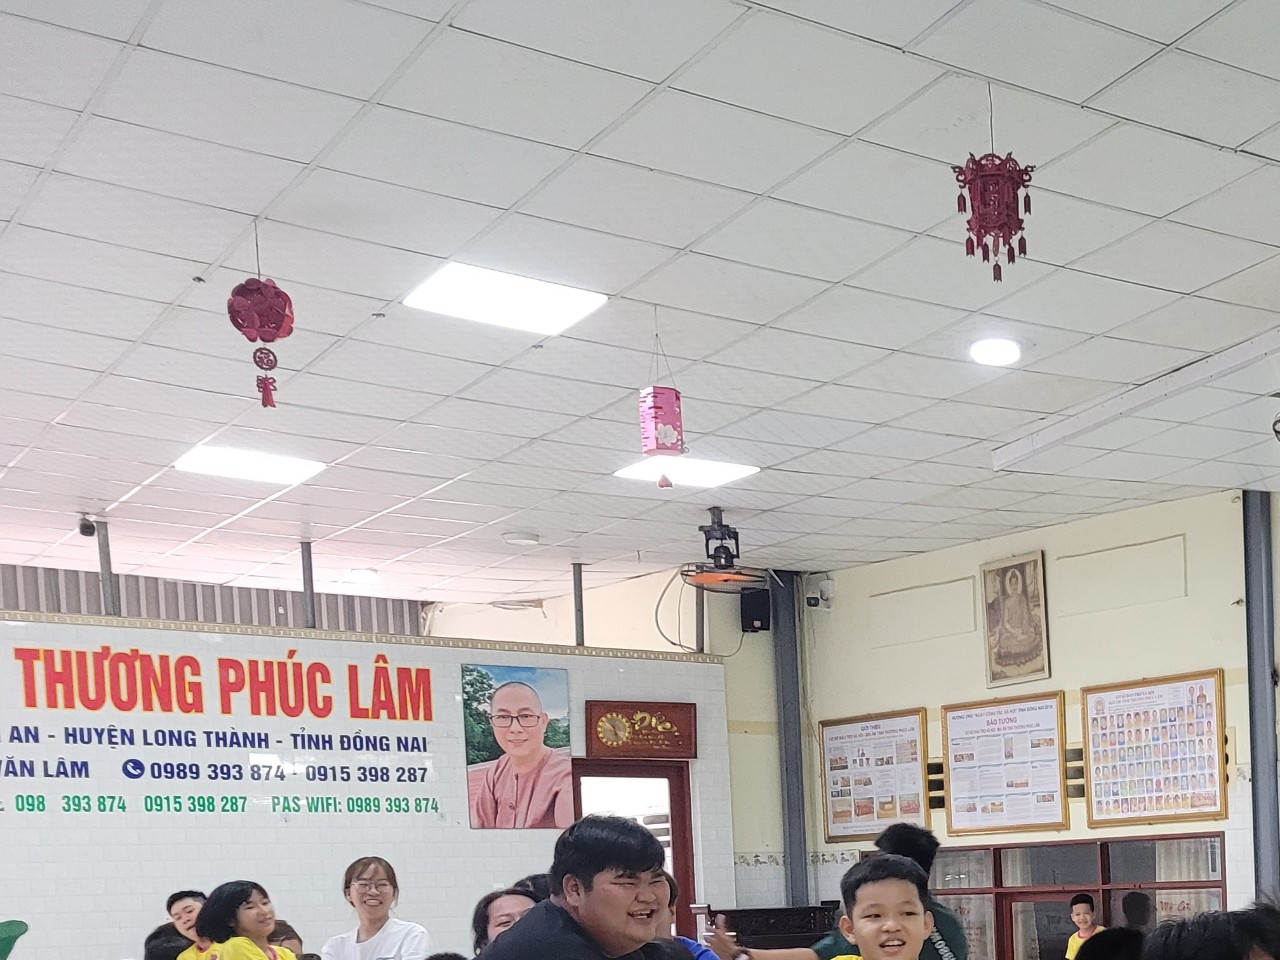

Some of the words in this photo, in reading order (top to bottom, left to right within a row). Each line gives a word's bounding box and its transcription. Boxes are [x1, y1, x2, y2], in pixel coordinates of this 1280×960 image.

[13, 645, 204, 714] THƯƠNG
[217, 648, 334, 719] PHÚC
[347, 653, 434, 722] LÂM
[8, 726, 40, 744] AN
[64, 724, 135, 750] HUYỆN
[142, 729, 197, 748] LONG
[203, 727, 270, 749] THÀNH
[290, 727, 334, 750] TỈNH
[340, 729, 390, 752] ĐỒNG
[396, 736, 428, 752] NAI
[0, 756, 34, 778] ĂN
[44, 757, 90, 778] LÂM
[150, 762, 200, 780] 0989
[207, 764, 244, 781] 393
[250, 764, 286, 781] 874
[305, 765, 350, 782] 0915
[357, 766, 390, 782] 398
[396, 766, 428, 783] 287
[15, 794, 46, 812] 098
[62, 795, 92, 812] 393
[97, 795, 126, 812] 874
[144, 796, 182, 812] 0915
[188, 796, 216, 812] 398
[221, 796, 248, 813] 287
[272, 796, 300, 813] PAS
[306, 796, 342, 813] WIFI:
[347, 797, 380, 814] 0989
[386, 797, 410, 814] 393
[414, 798, 439, 814] 874
